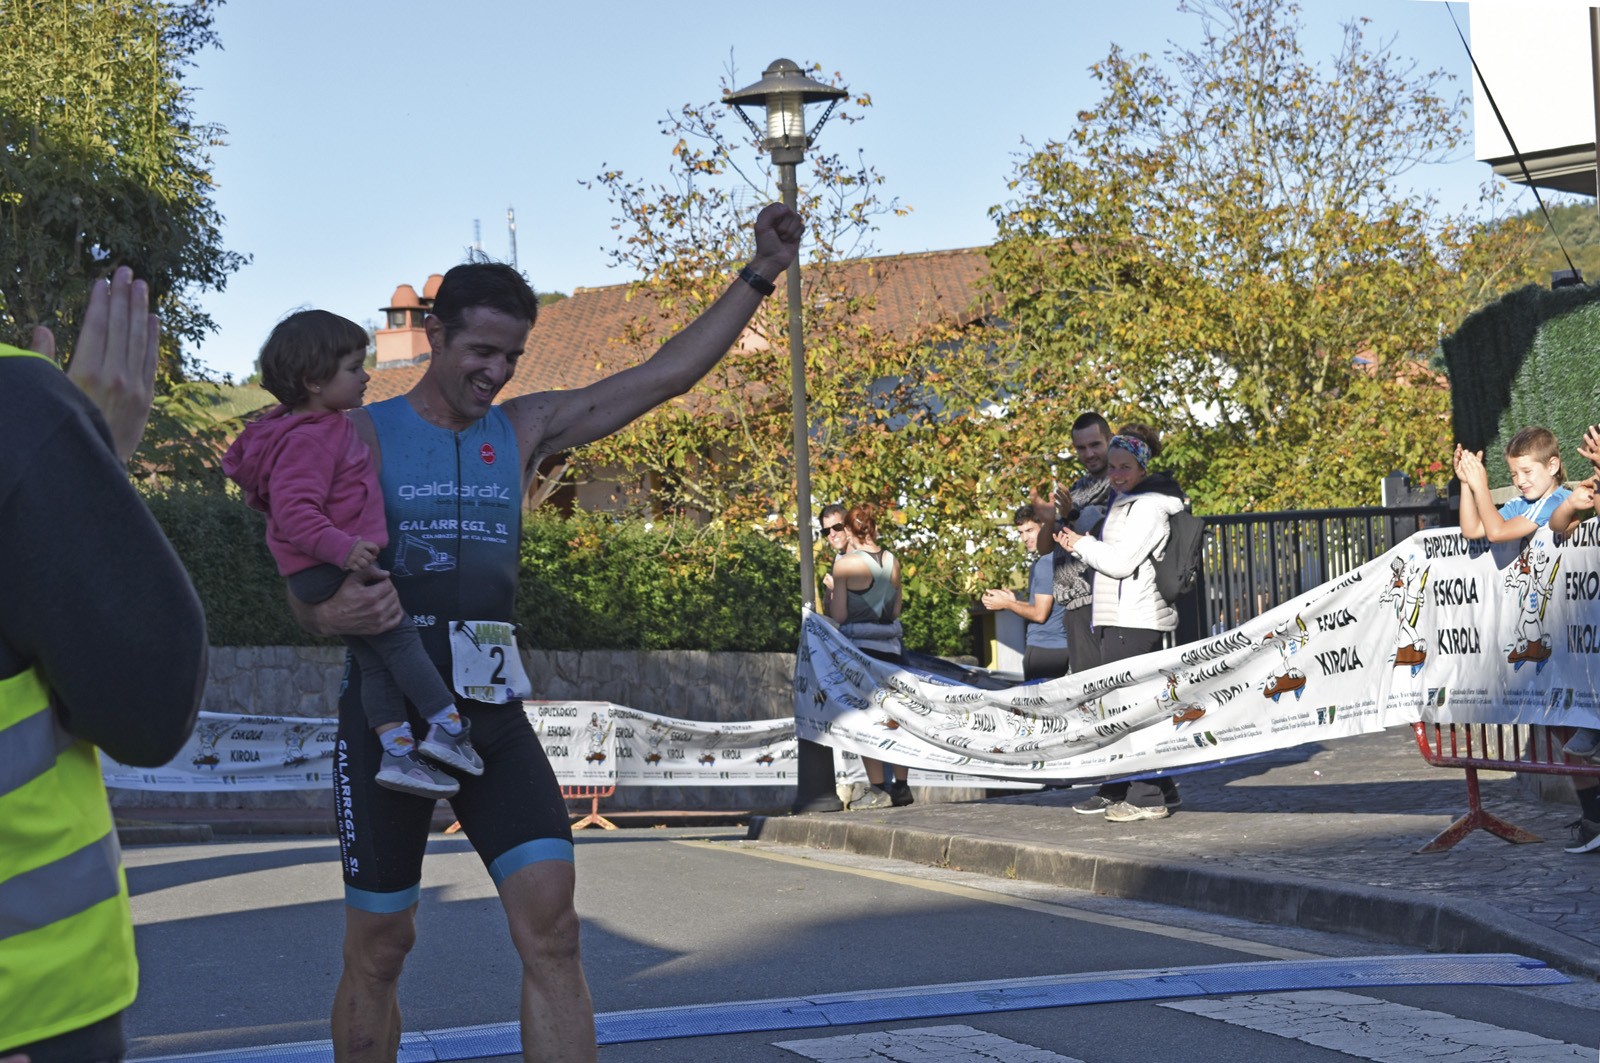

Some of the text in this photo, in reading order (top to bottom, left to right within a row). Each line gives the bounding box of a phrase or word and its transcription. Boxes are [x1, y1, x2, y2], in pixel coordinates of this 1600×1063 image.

[495, 523, 509, 535] SL
[1433, 577, 1480, 606] ESKOLA
[1565, 571, 1600, 600] ESKO
[1437, 627, 1481, 655] KIROLA
[1567, 624, 1600, 654] KIROL
[489, 646, 507, 685] 2
[1314, 645, 1364, 676] KIROLA
[538, 706, 578, 718] GIPUZKOAKO
[230, 750, 261, 762] KIROLA
[721, 749, 742, 760] KIROLA
[349, 857, 360, 877] SL
